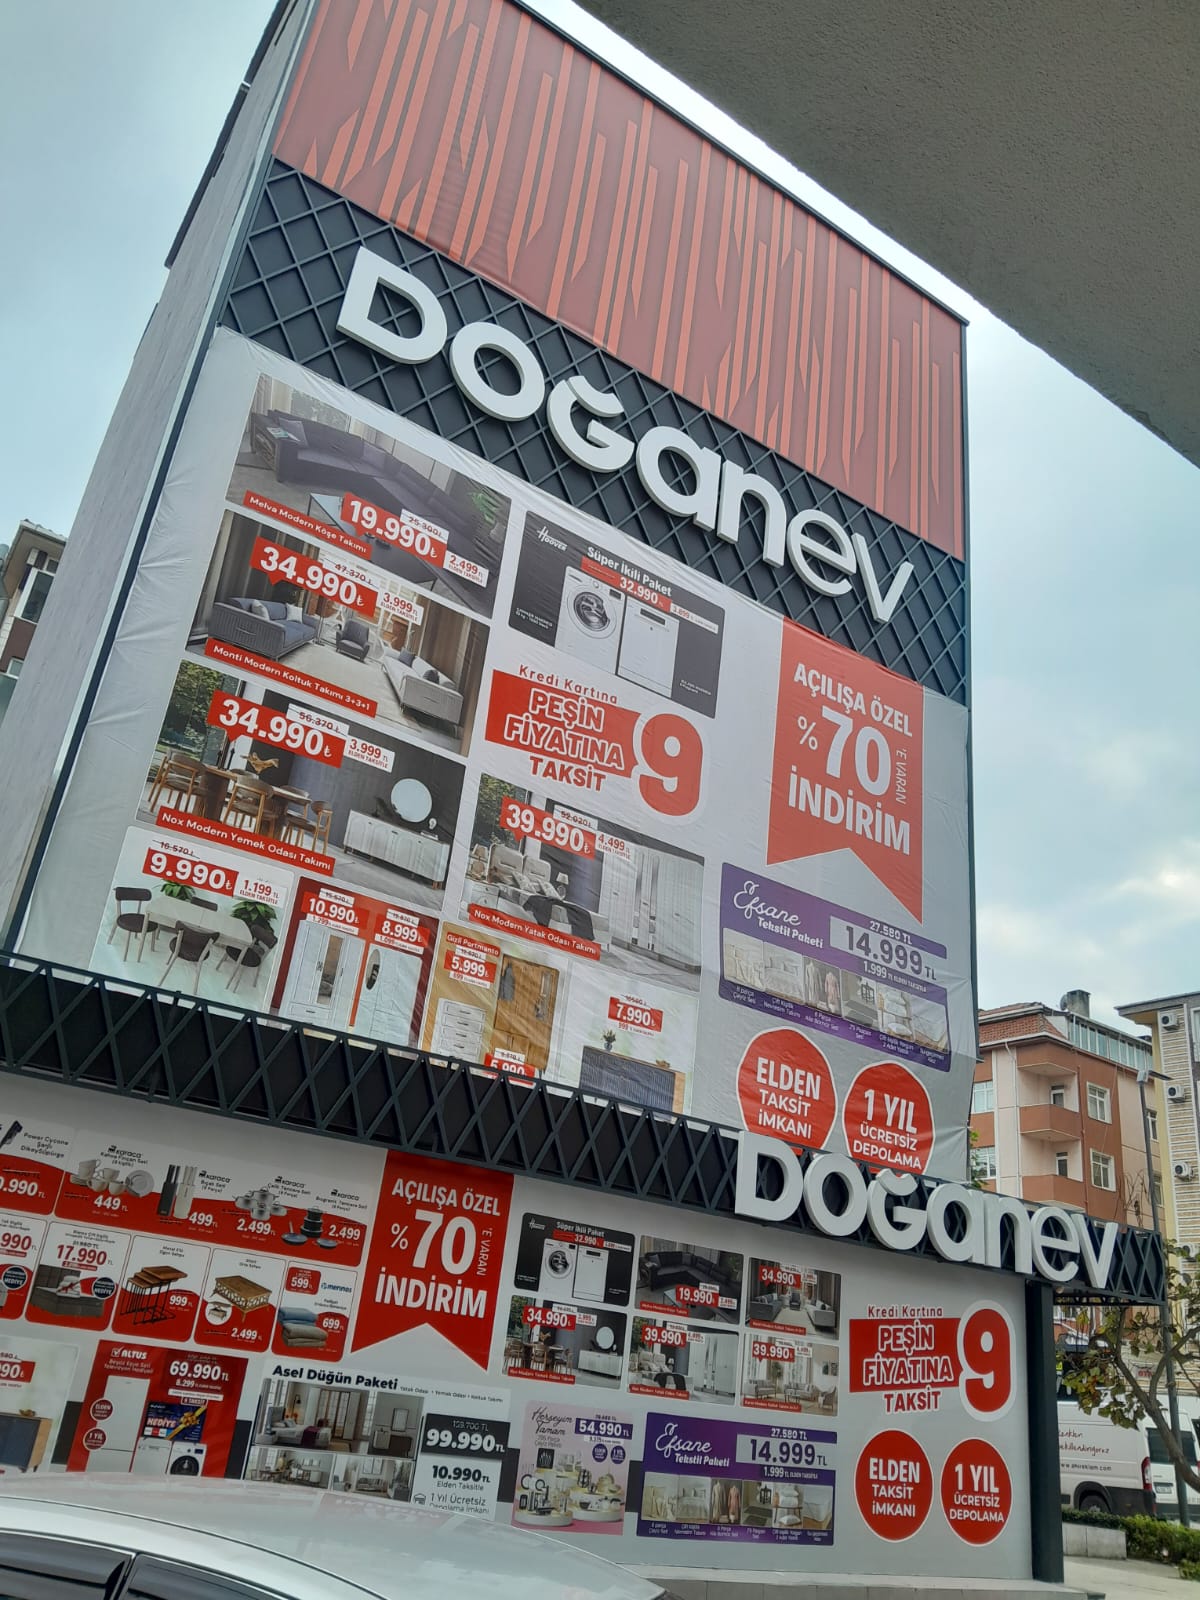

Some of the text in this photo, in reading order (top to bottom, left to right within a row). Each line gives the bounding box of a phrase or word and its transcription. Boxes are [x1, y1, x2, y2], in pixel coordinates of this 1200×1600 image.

[250, 496, 367, 553] Melva Modern Köşe Takımı
[449, 554, 478, 575] 2.499
[587, 547, 672, 597] Süper İkili Paket
[384, 592, 412, 612] 3.999
[619, 577, 658, 605] 32.990
[213, 645, 370, 710] Monti Modern Koltuk Takımı 3+3+1
[519, 665, 617, 704] Kredi Kartına
[529, 688, 604, 732] PEŞİN
[794, 663, 912, 737] AÇILIŞA ÖZEL
[350, 738, 382, 758] 3.999
[505, 713, 624, 770] FİYATINA
[530, 756, 606, 791] TAKSİT
[639, 713, 703, 816] 9
[896, 762, 907, 805] VARAN
[788, 765, 910, 855] İNDİRİM
[162, 813, 331, 871] Nox Modern Yemek Odası Takımı
[598, 834, 625, 851] 4.499
[242, 880, 272, 896] 1.199
[733, 880, 800, 926] Efsane
[447, 934, 461, 945] Gizli
[475, 910, 596, 955] Nox Modern Yatak Odası Takımı
[757, 916, 823, 949] Tekstil Paketi
[870, 921, 913, 945] 27.580 TL
[846, 925, 936, 980] 14.999 TL
[863, 961, 888, 979] 1.999
[757, 1057, 821, 1100] ELDEN
[760, 1089, 811, 1117] TAKSİT
[865, 1089, 917, 1134] 1 YIL
[758, 1109, 812, 1139] İMKANI
[23, 1132, 44, 1141] Power
[861, 1121, 917, 1151] ÜCRETSİZ
[116, 1149, 142, 1158] karaca
[854, 1140, 922, 1170] DEPOLAMA
[206, 1173, 231, 1183] karaca
[281, 1179, 305, 1189] karaca
[94, 1195, 121, 1210] 449
[337, 1192, 359, 1201] karaca
[392, 1178, 501, 1216] AÇILIŞA ÖZEL
[189, 1212, 213, 1226] 499
[237, 1218, 271, 1235] 2.499
[557, 1222, 574, 1232] Süper
[588, 1228, 605, 1237] Paket
[329, 1225, 360, 1240] 2.499
[575, 1234, 597, 1245] 32.990
[57, 1245, 107, 1265] 17.990
[477, 1240, 490, 1276] VARAN
[291, 1277, 309, 1288] 599
[376, 1267, 487, 1318] İNDİRİM
[170, 1295, 188, 1306] 999
[868, 1305, 943, 1317] Kredi Kartına
[232, 1328, 258, 1340] 2.499
[322, 1318, 340, 1330] 699
[878, 1320, 935, 1356] PEŞİN
[170, 1361, 220, 1381] 69.990
[863, 1353, 954, 1385] FİYATINA
[963, 1309, 1010, 1412] 9
[273, 1365, 398, 1390] Asel Düğün Paketi
[884, 1387, 941, 1413] TAKSİT
[579, 1420, 622, 1436] 54.990
[799, 1431, 807, 1440] TL
[426, 1429, 505, 1452] 99.990 TL
[656, 1422, 712, 1458] Efsane
[675, 1453, 730, 1467] Tekstil Paketi
[750, 1439, 827, 1466] 14.999 TL
[432, 1465, 482, 1482] 10.990
[764, 1467, 784, 1477] 1.999
[869, 1458, 920, 1483] ELDEN
[955, 1464, 999, 1493] 1 YIL
[437, 1481, 484, 1492] Elden Taksitle
[872, 1484, 913, 1499] TAKSİT
[437, 1493, 448, 1504] Yıl
[450, 1493, 486, 1506] Ücretsiz
[872, 1501, 915, 1517] İMKANI
[954, 1492, 1000, 1508] ÜCRETSİZ
[950, 1509, 1004, 1522] DEPOLAMA
